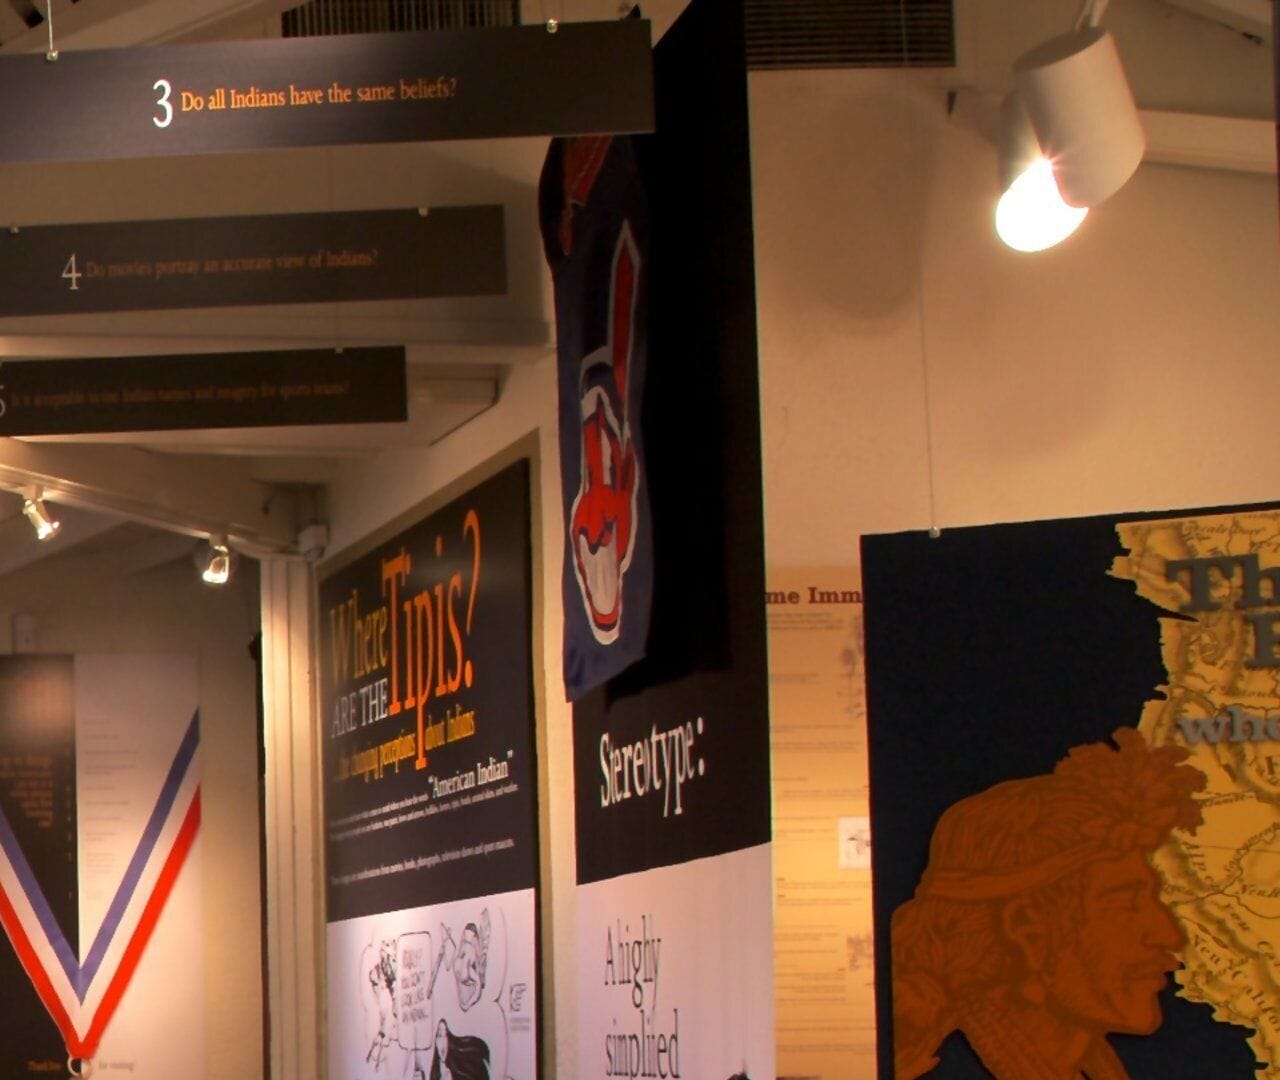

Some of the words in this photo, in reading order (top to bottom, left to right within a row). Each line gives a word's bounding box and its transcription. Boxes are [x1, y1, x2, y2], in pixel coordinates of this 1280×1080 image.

[152, 79, 173, 128] 3
[181, 91, 204, 111] Do
[208, 88, 225, 110] all
[230, 86, 286, 109] Indians
[290, 84, 323, 105] have
[328, 83, 352, 103] the
[357, 86, 393, 101] same
[399, 77, 457, 100] beliefs?
[61, 252, 82, 290] 4
[330, 589, 388, 687] Where
[382, 508, 480, 771] Tipis?
[331, 683, 357, 738] ARE
[360, 677, 389, 726] THE
[605, 926, 615, 985] A
